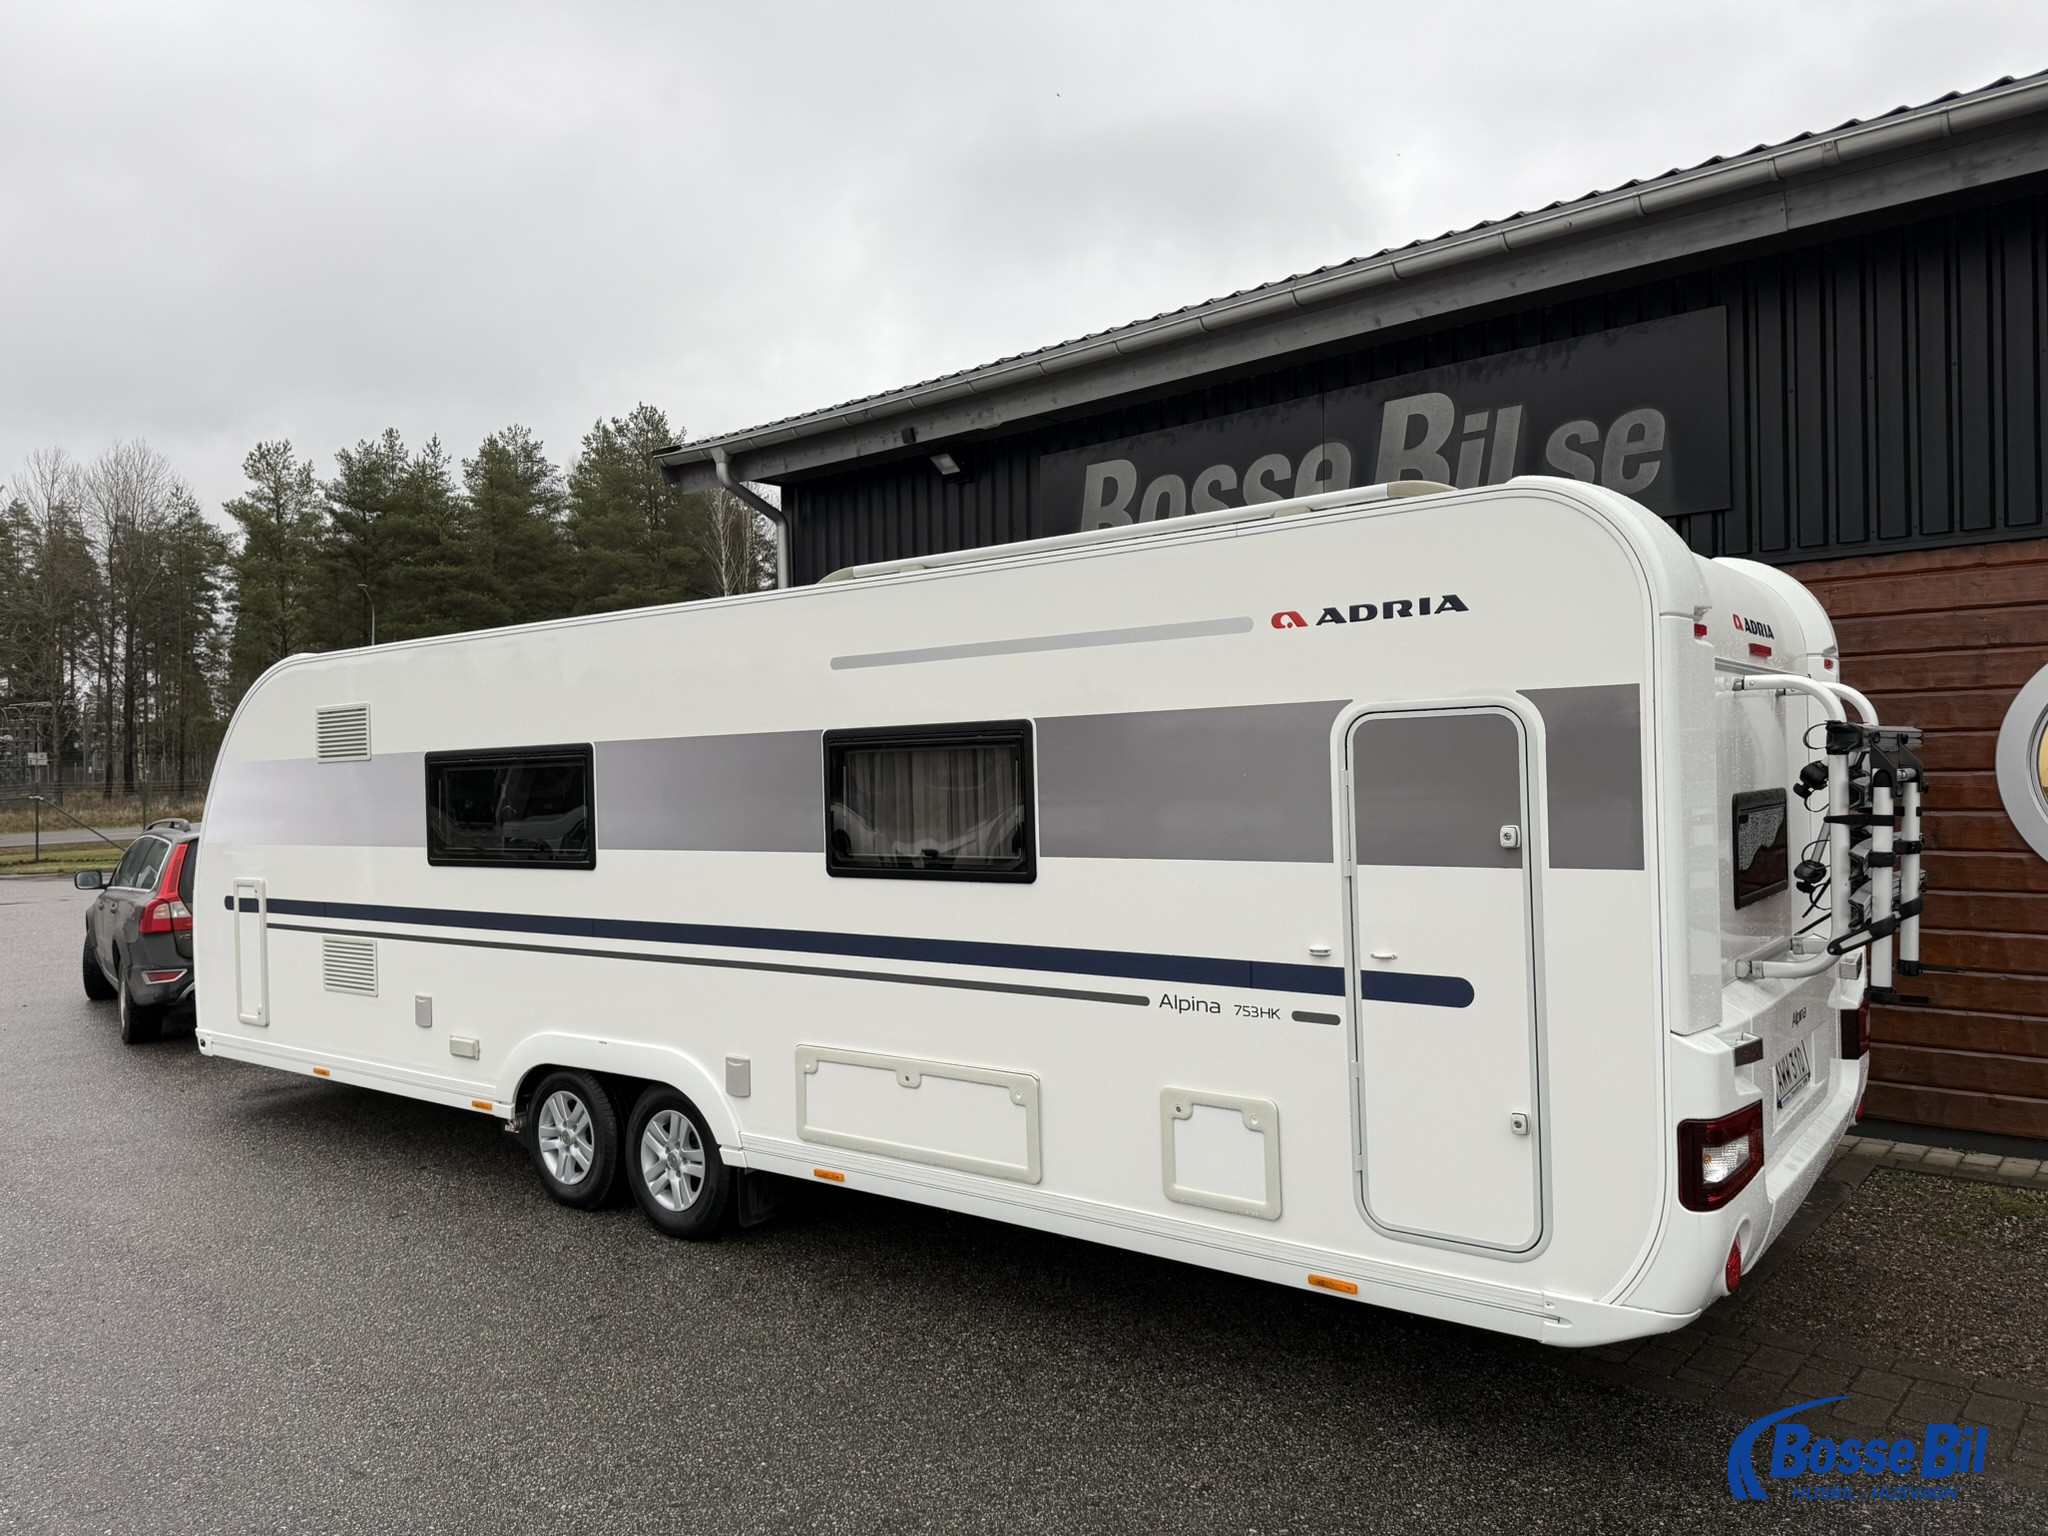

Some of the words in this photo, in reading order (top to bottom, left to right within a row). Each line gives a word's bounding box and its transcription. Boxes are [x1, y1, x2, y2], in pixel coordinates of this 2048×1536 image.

[1080, 442, 1352, 532] Bosse
[1374, 392, 1522, 490] Bil
[1546, 408, 1666, 494] se
[1315, 594, 1470, 626] ADRIA
[1743, 617, 1775, 640] ADRIA
[1159, 993, 1221, 1014] Alpina
[1233, 1004, 1281, 1020] 753HK
